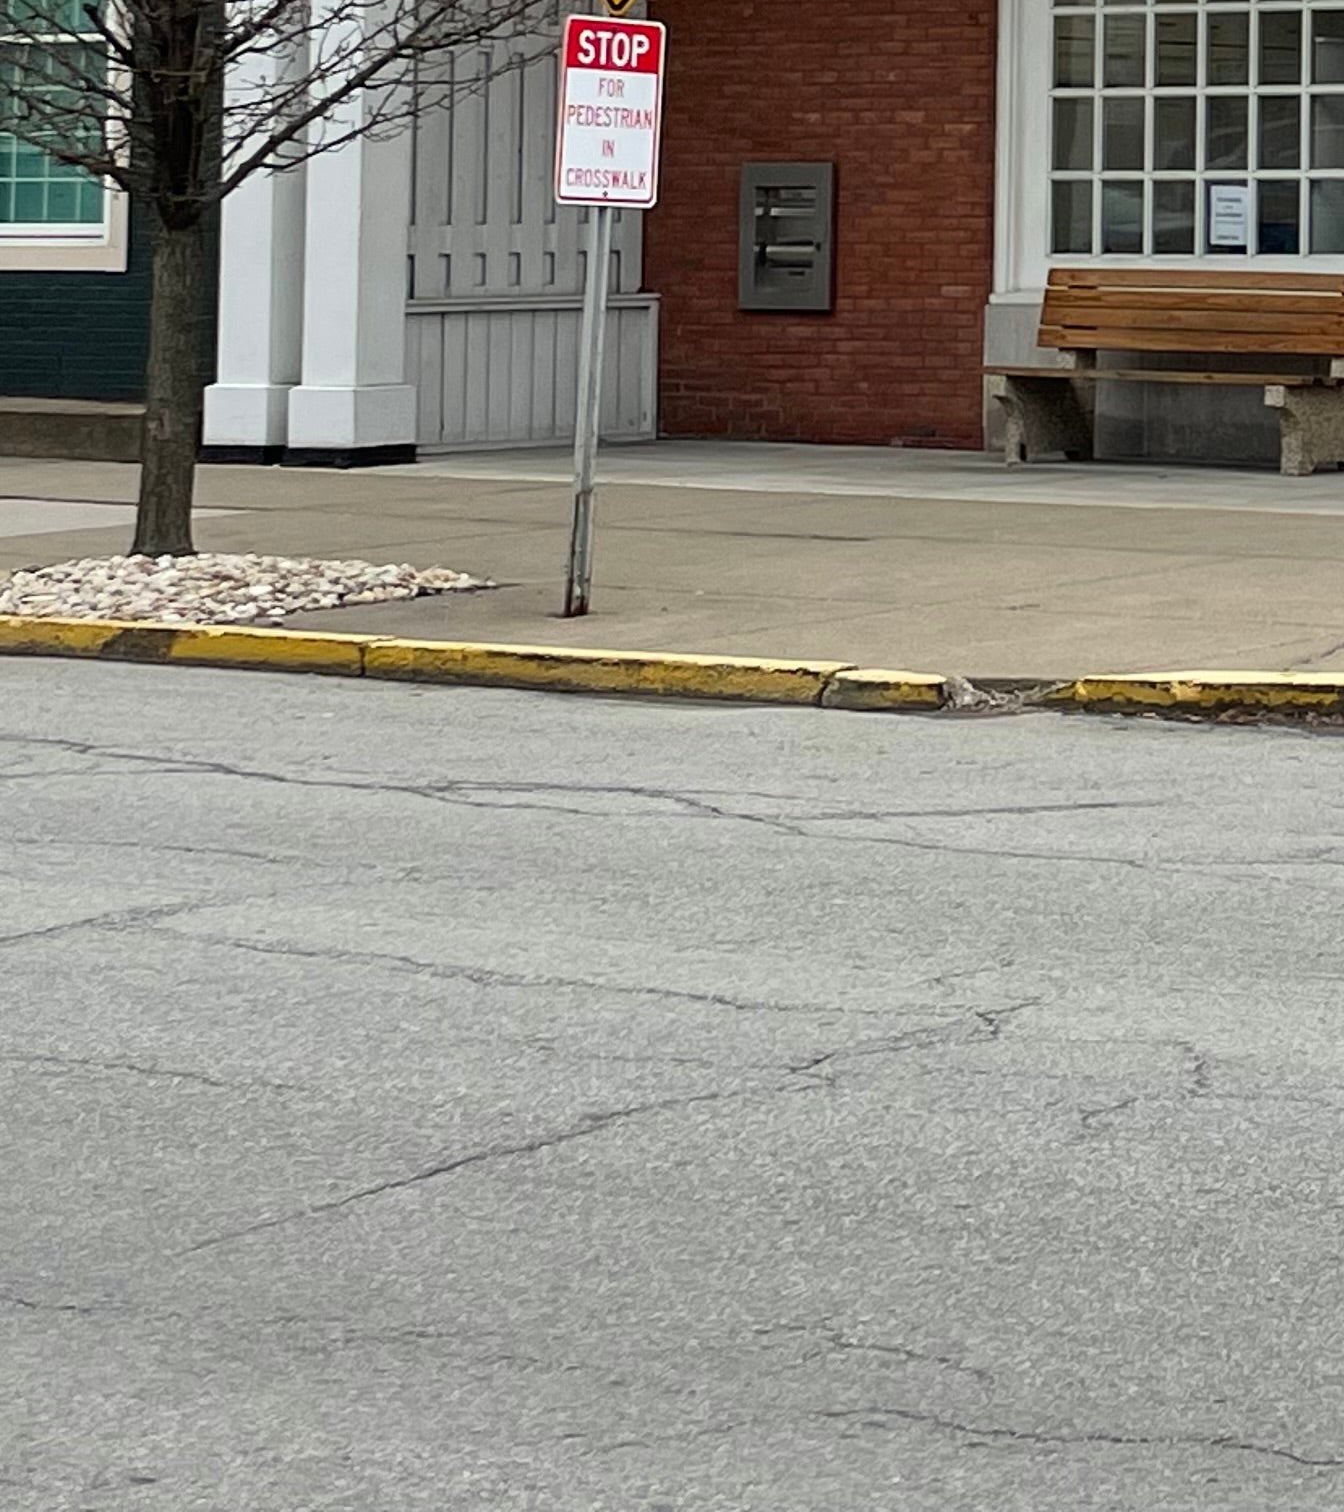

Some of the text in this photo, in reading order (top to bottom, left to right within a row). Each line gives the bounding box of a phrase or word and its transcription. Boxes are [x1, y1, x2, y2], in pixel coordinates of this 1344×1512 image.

[577, 29, 650, 68] STOP
[598, 77, 625, 98] FOR
[567, 104, 653, 129] PEDESTRIAN
[602, 139, 616, 158] IN
[566, 168, 648, 189] CROSSWALK
